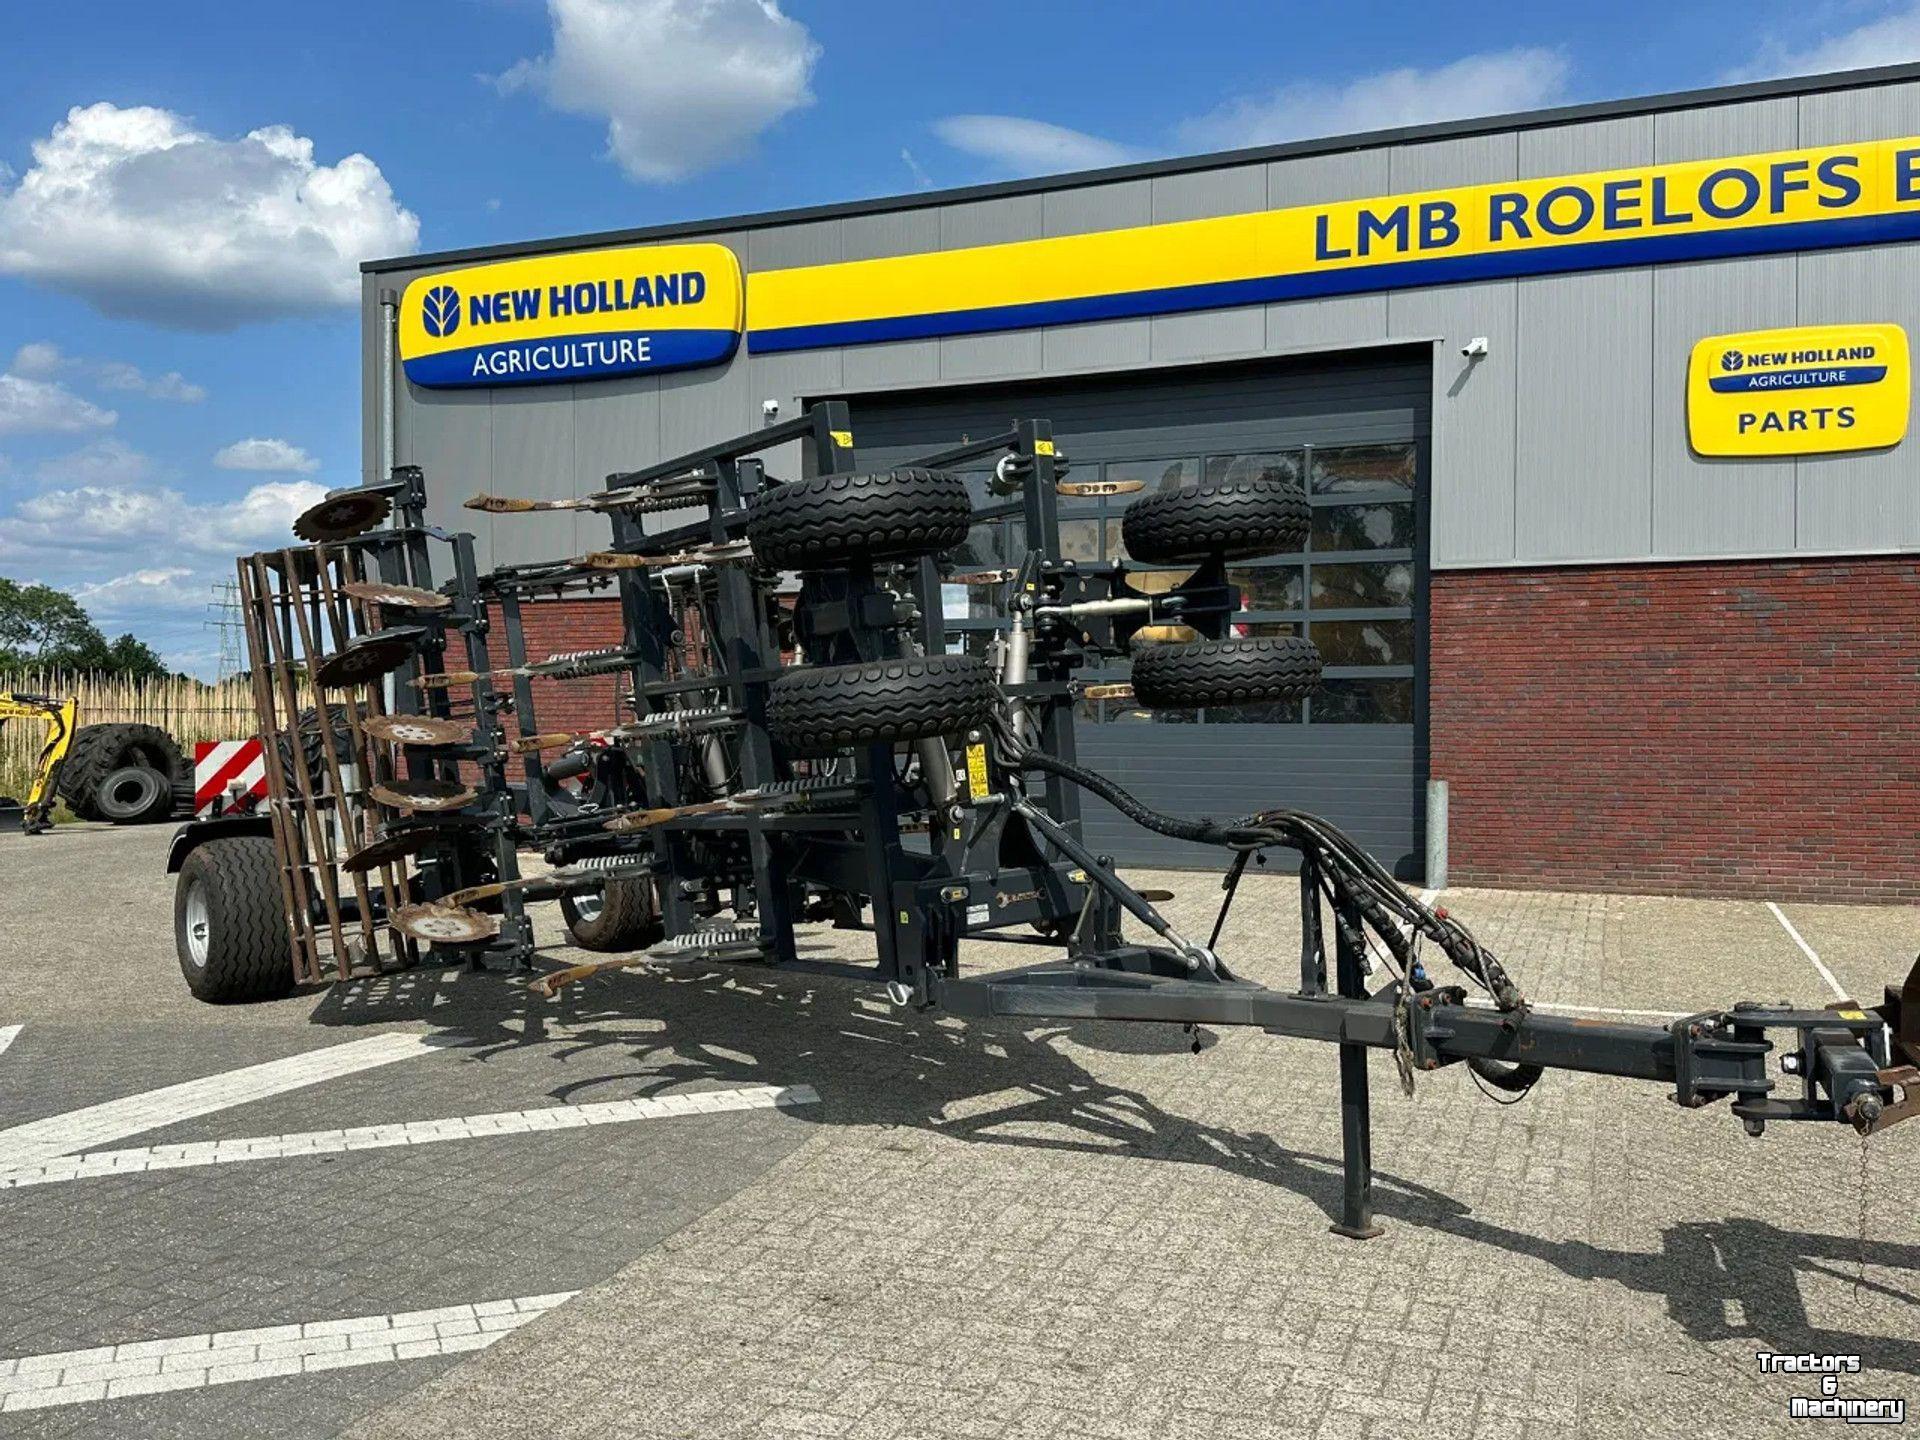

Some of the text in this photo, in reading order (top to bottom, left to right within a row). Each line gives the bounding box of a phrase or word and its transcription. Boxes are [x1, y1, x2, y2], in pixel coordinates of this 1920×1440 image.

[1315, 200, 1460, 261] LMB
[1489, 154, 1861, 242] ROELOFS
[470, 271, 706, 326] NEW HOLLAND
[472, 337, 651, 376] AGRICULTURE
[1747, 346, 1875, 367] NEW HOLLAND
[1749, 370, 1847, 387] AGRICULTURE
[1738, 406, 1856, 434] PARTS
